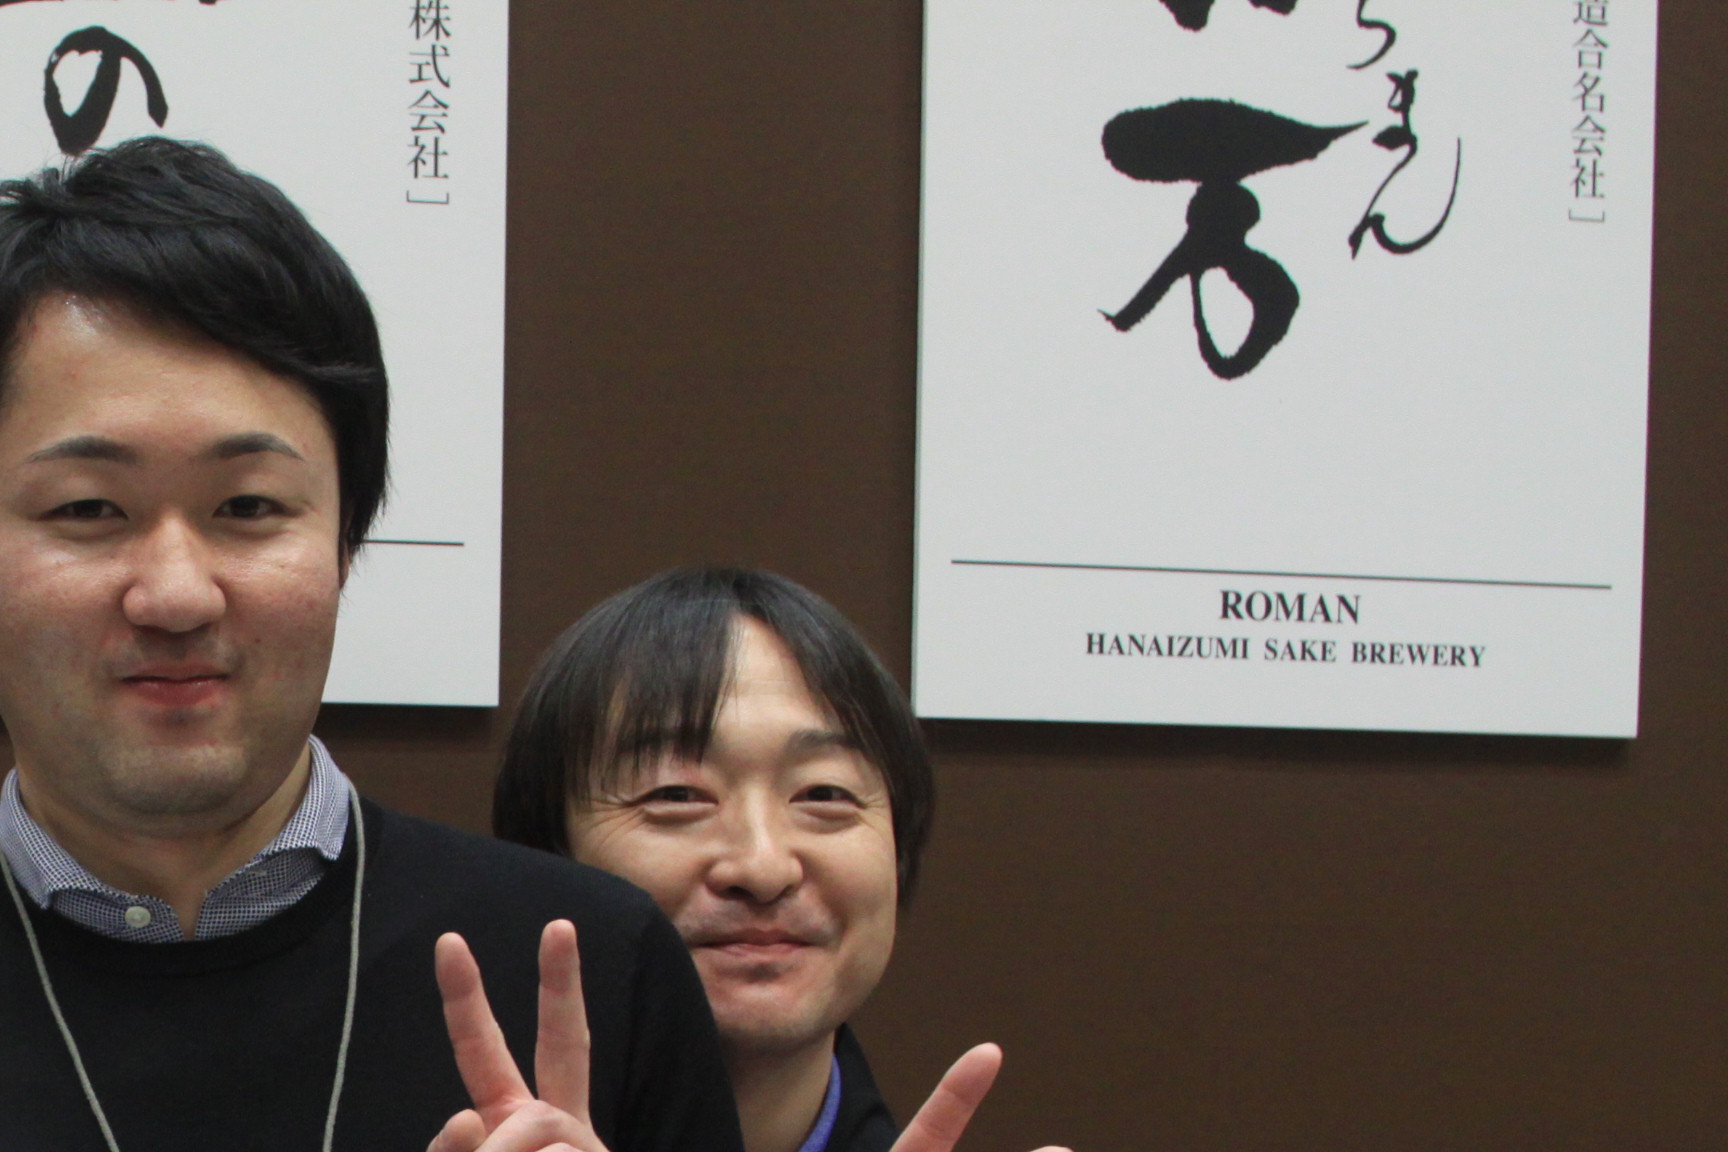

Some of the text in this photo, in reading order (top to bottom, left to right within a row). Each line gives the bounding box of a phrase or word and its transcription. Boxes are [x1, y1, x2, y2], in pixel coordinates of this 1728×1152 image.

[1218, 590, 1361, 625] ROMAN
[1085, 632, 1486, 668] HANAIZUMI SAKE BREWERY
